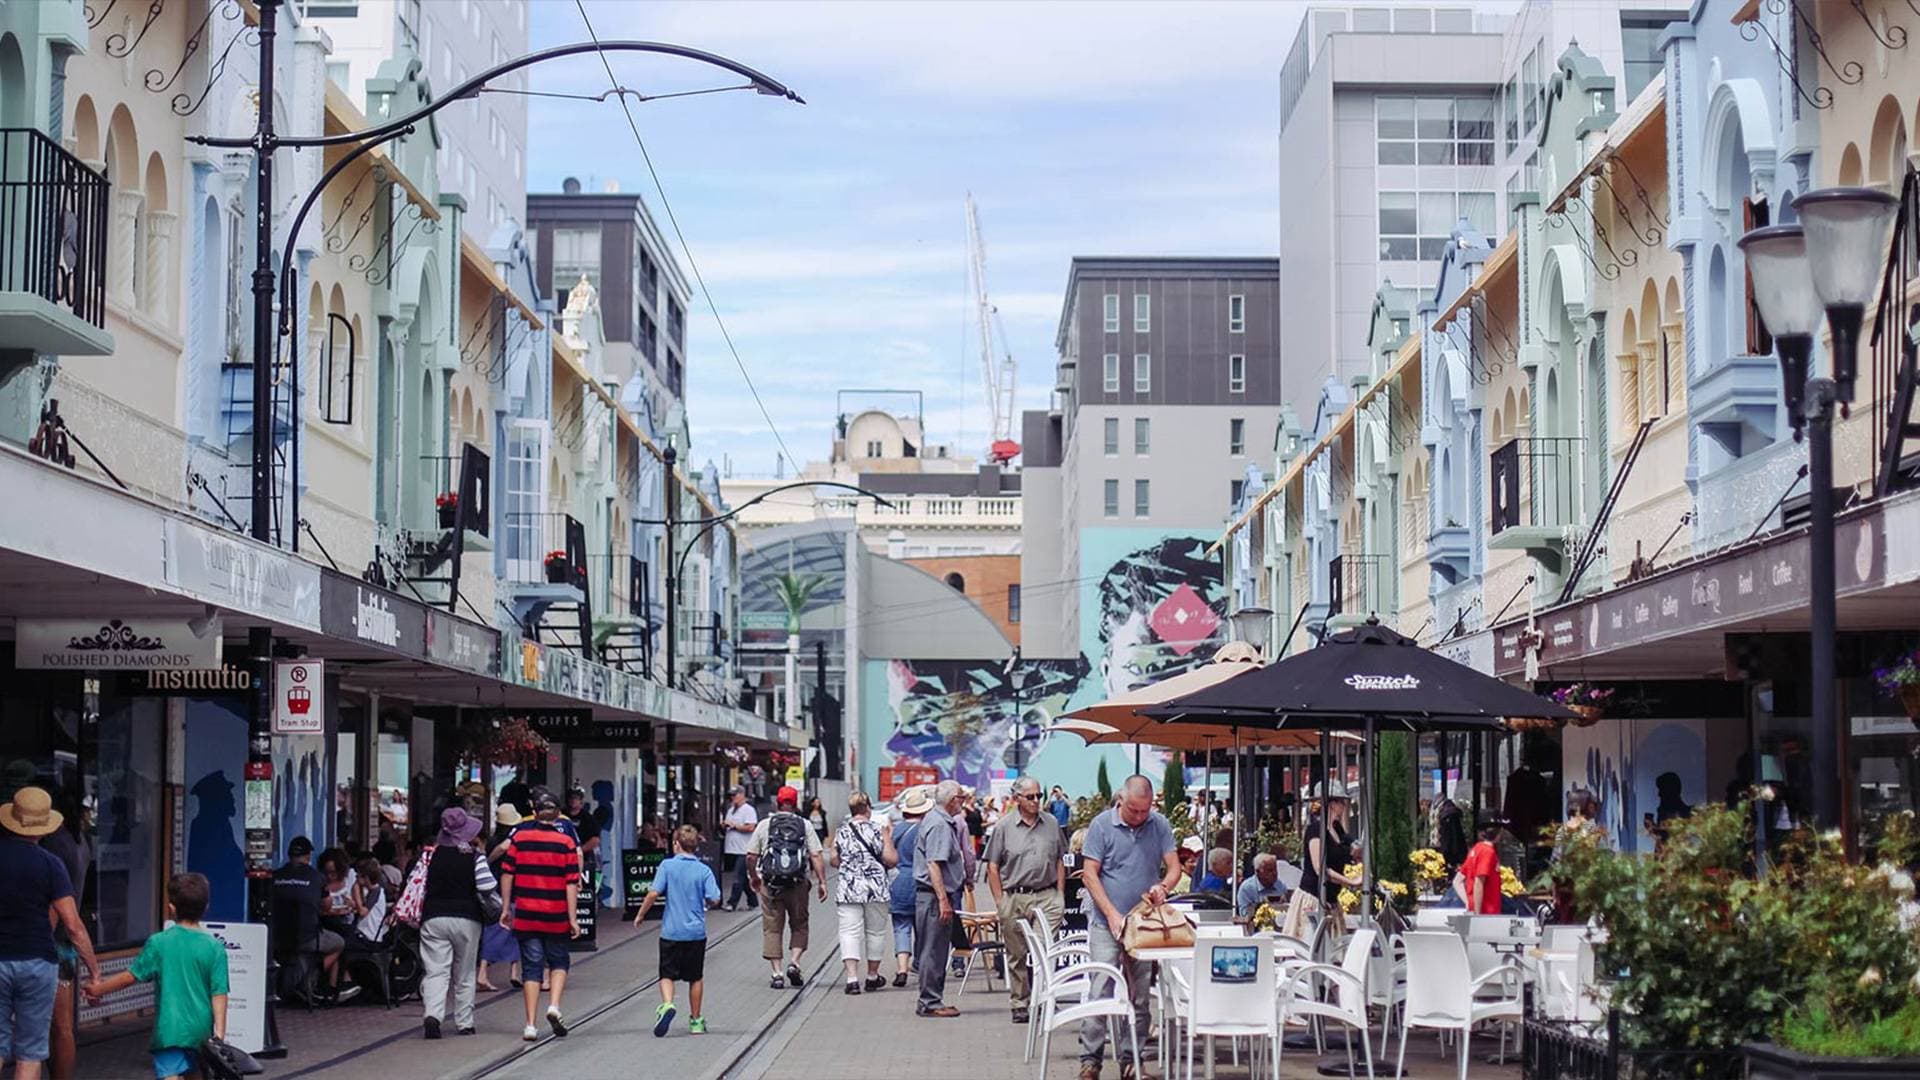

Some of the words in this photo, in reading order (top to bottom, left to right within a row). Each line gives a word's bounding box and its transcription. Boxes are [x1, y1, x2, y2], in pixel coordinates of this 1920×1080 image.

[42, 653, 109, 666] POLISHED
[113, 653, 190, 667] DIAMONDS
[147, 663, 250, 689] Institutio
[1344, 674, 1420, 686] Switch
[280, 719, 298, 727] Tram
[538, 716, 579, 727] GIFTS
[604, 728, 640, 737] GIFTS
